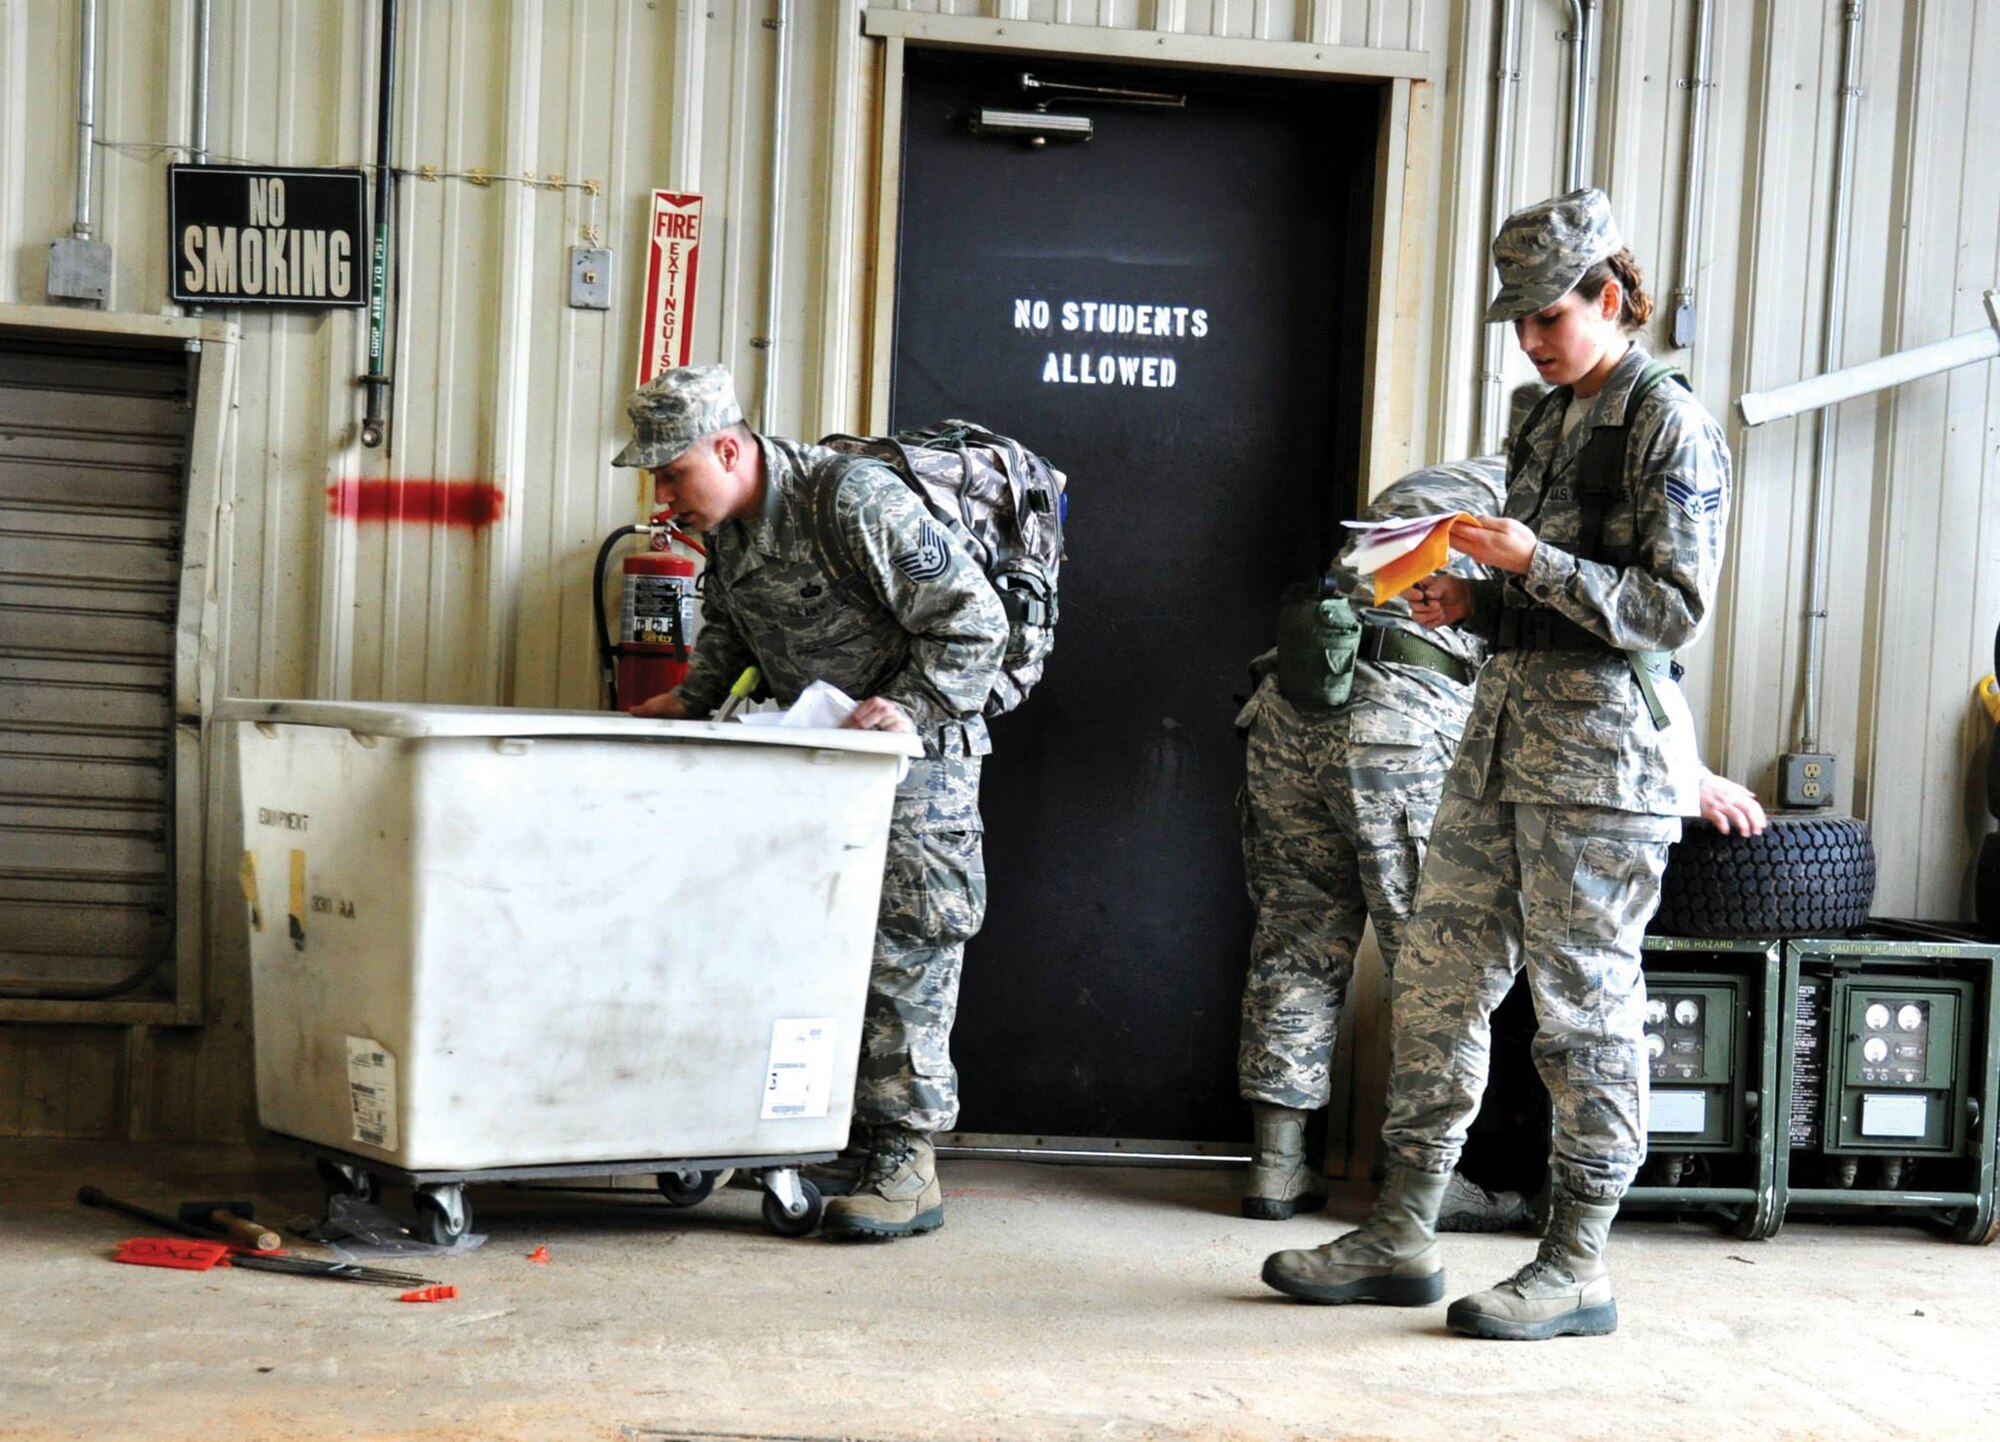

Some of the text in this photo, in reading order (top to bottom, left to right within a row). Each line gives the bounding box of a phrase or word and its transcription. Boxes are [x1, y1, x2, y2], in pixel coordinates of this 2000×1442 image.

[249, 177, 286, 228] NO
[656, 211, 698, 240] FIRE
[183, 225, 351, 298] SMOKING
[370, 238, 383, 357] COMP AIR 170 PSI
[1014, 298, 1209, 338] NO STUDENTS
[1042, 352, 1177, 388] ALLOWED
[1647, 938, 1734, 949] HEARING HAZARD
[1875, 944, 1918, 955] HEARING
[1921, 945, 1960, 955] HAZARD
